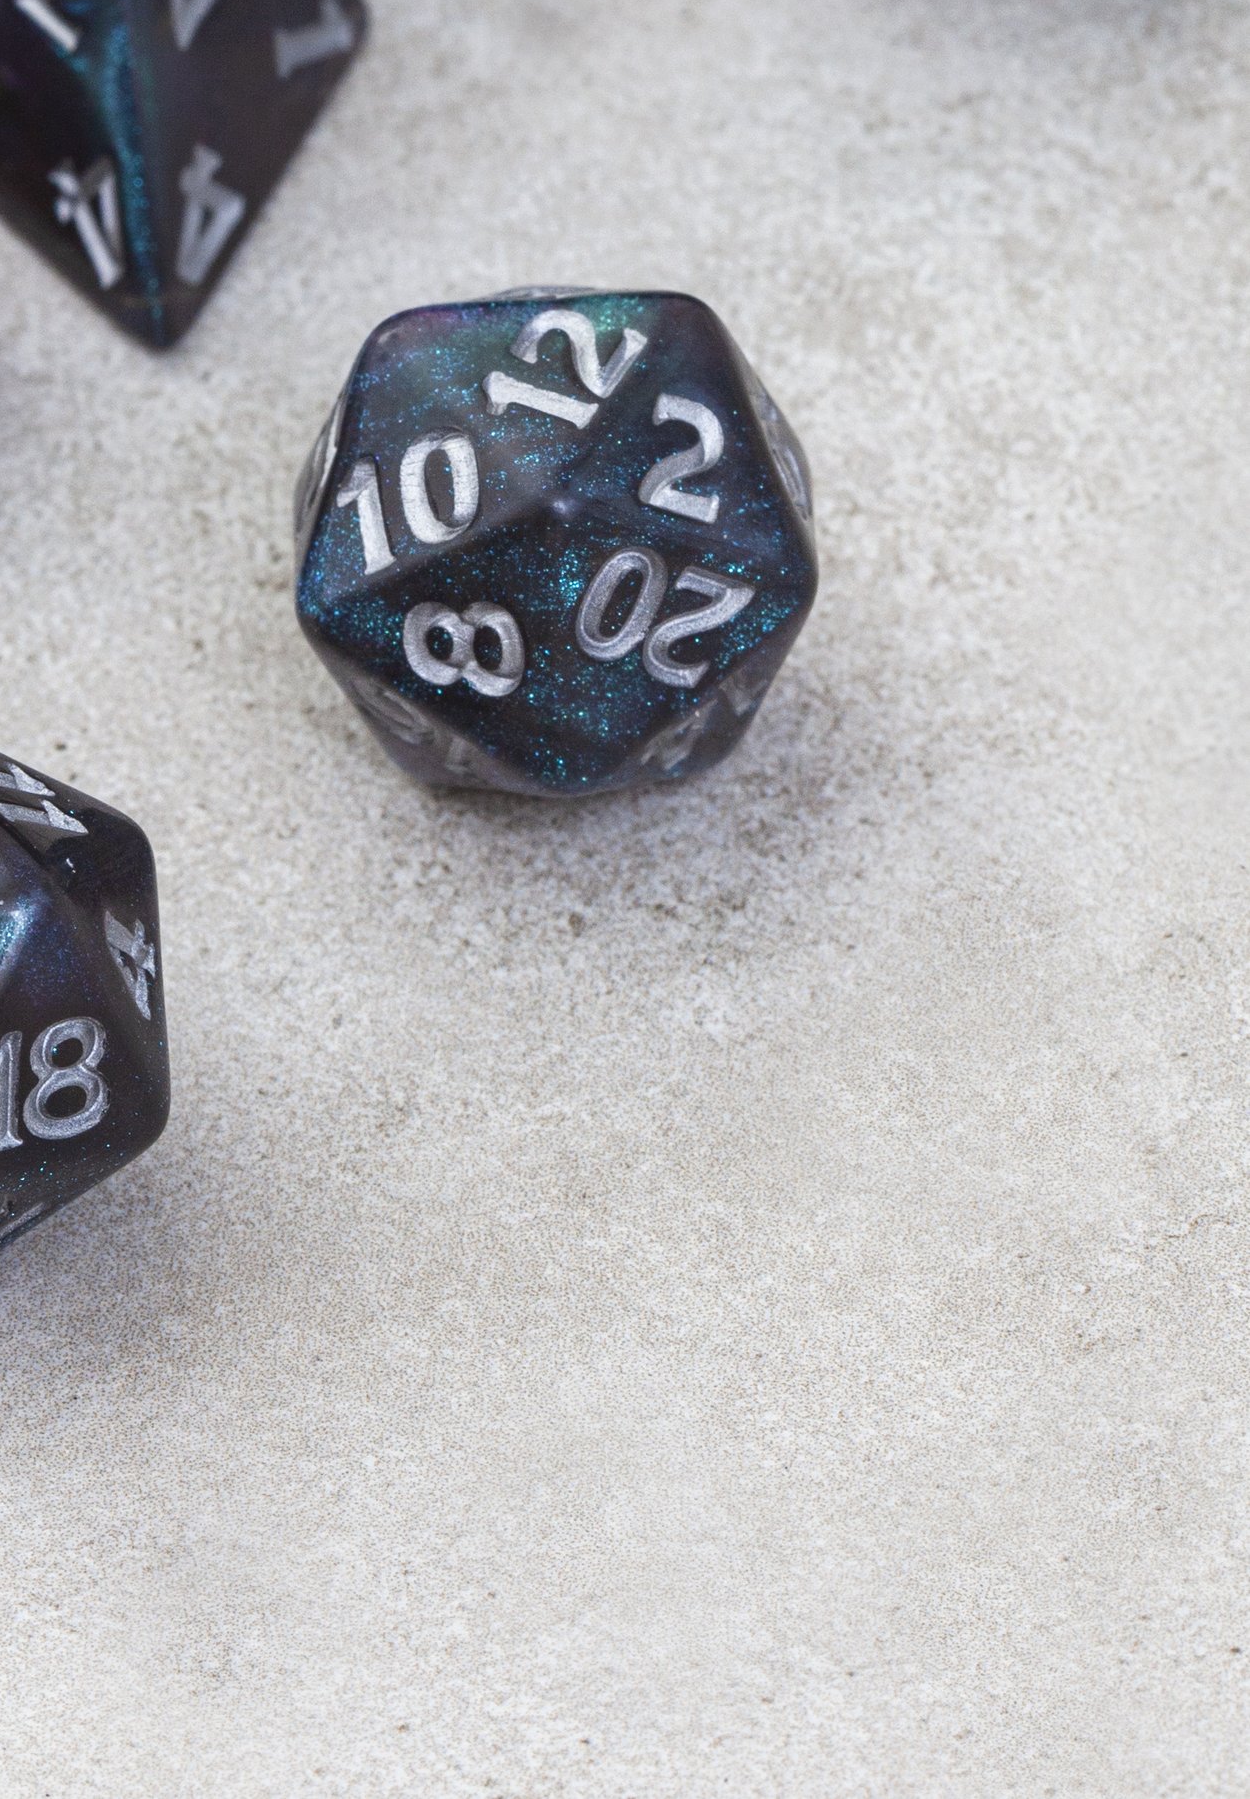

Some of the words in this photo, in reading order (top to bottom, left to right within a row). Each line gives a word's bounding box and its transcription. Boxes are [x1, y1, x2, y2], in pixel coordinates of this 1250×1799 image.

[49, 159, 124, 290] 4
[176, 143, 247, 286] 4
[482, 309, 648, 430] 12
[337, 425, 480, 576] 10
[639, 393, 725, 524] 2
[402, 601, 526, 697] 8
[575, 546, 755, 689] 20
[104, 910, 157, 1022] 4
